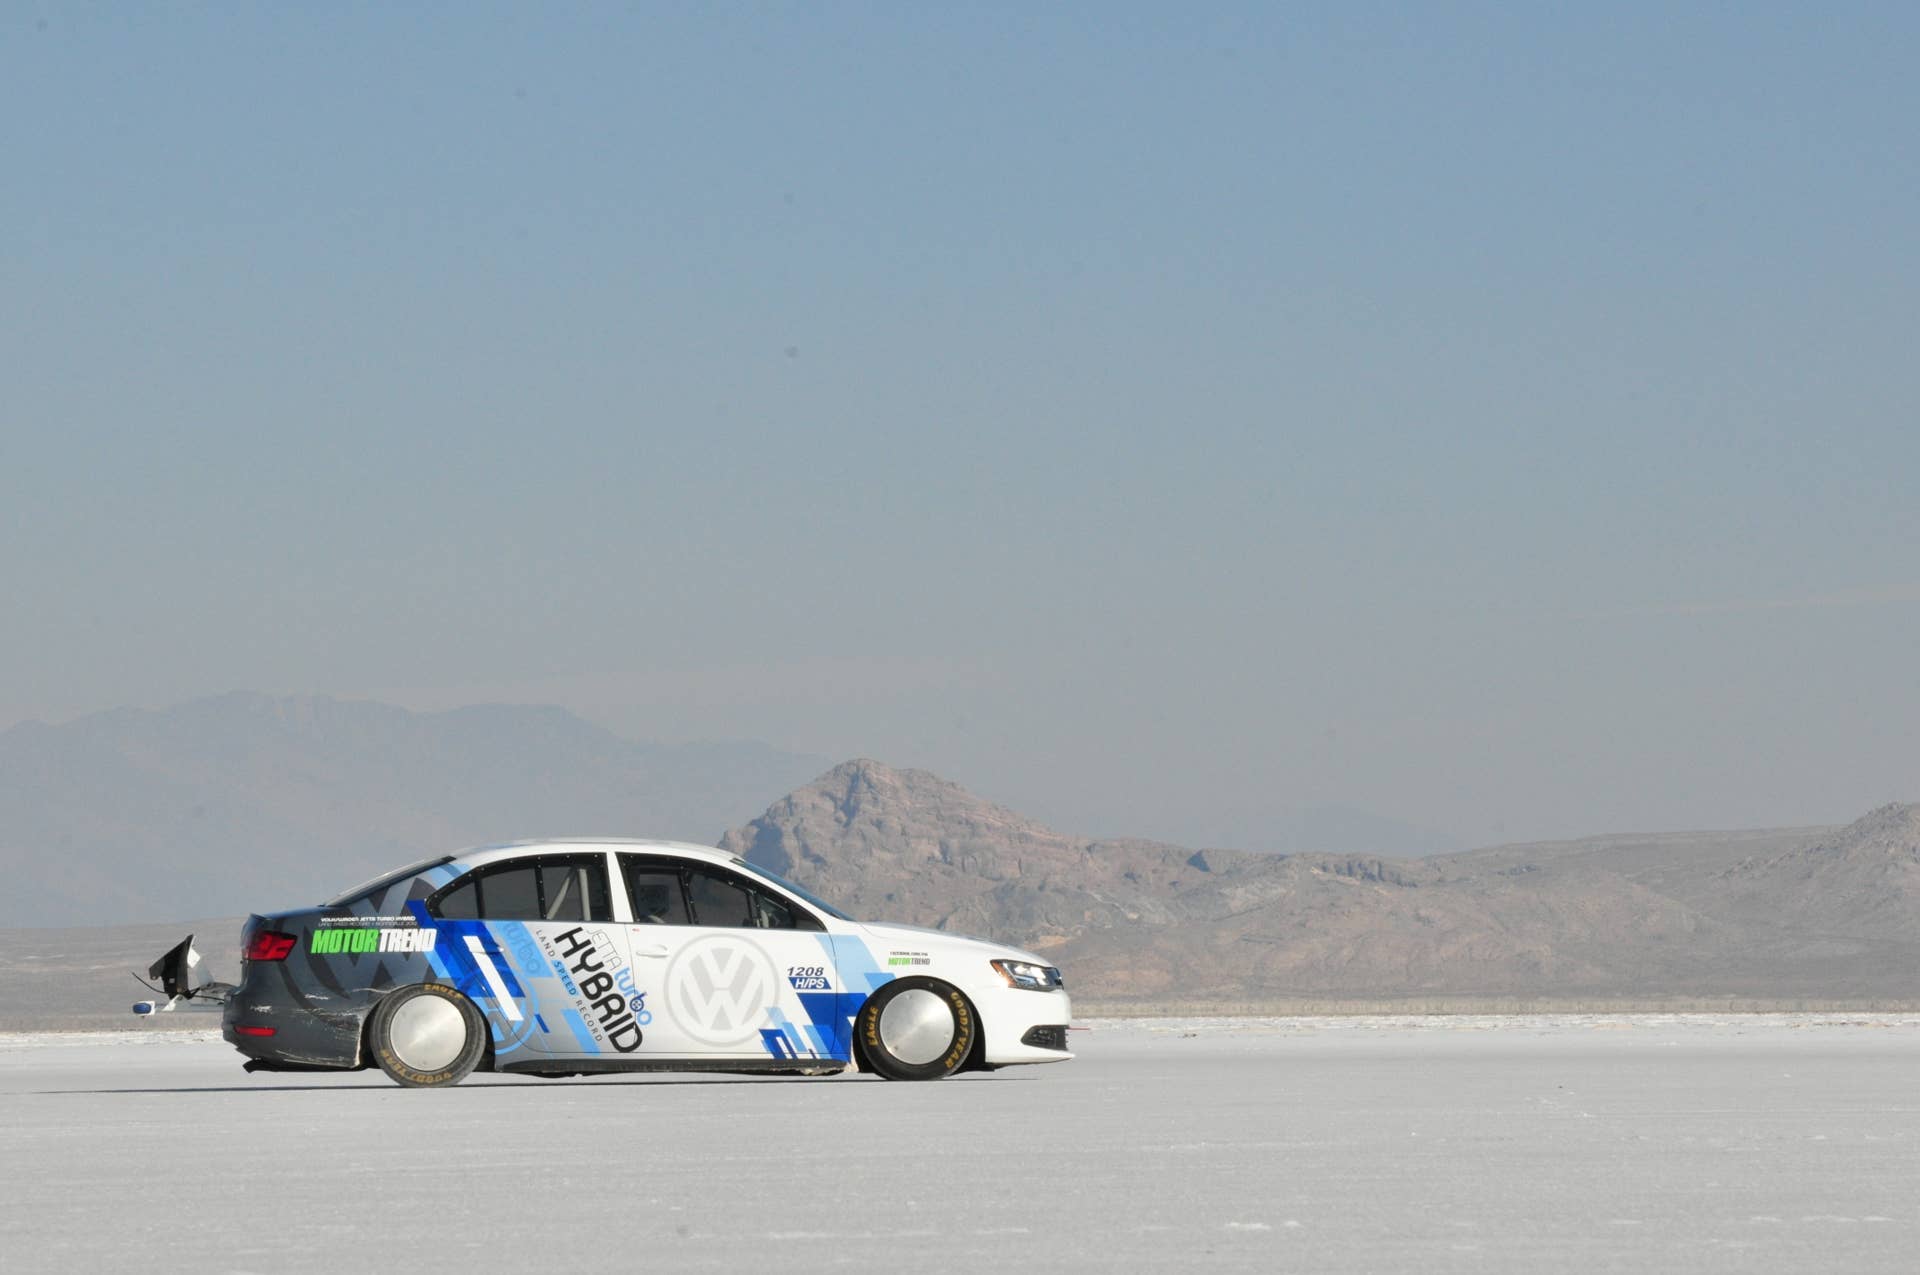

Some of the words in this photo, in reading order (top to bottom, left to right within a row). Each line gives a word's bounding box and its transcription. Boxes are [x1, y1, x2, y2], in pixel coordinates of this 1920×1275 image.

[536, 930, 556, 958] LAND
[553, 961, 577, 996] SPEED
[575, 1000, 603, 1042] RECORD
[553, 926, 643, 1053] HYBRID
[587, 929, 622, 971] JETTA
[614, 966, 653, 1026] turbo
[787, 966, 824, 977] 1208
